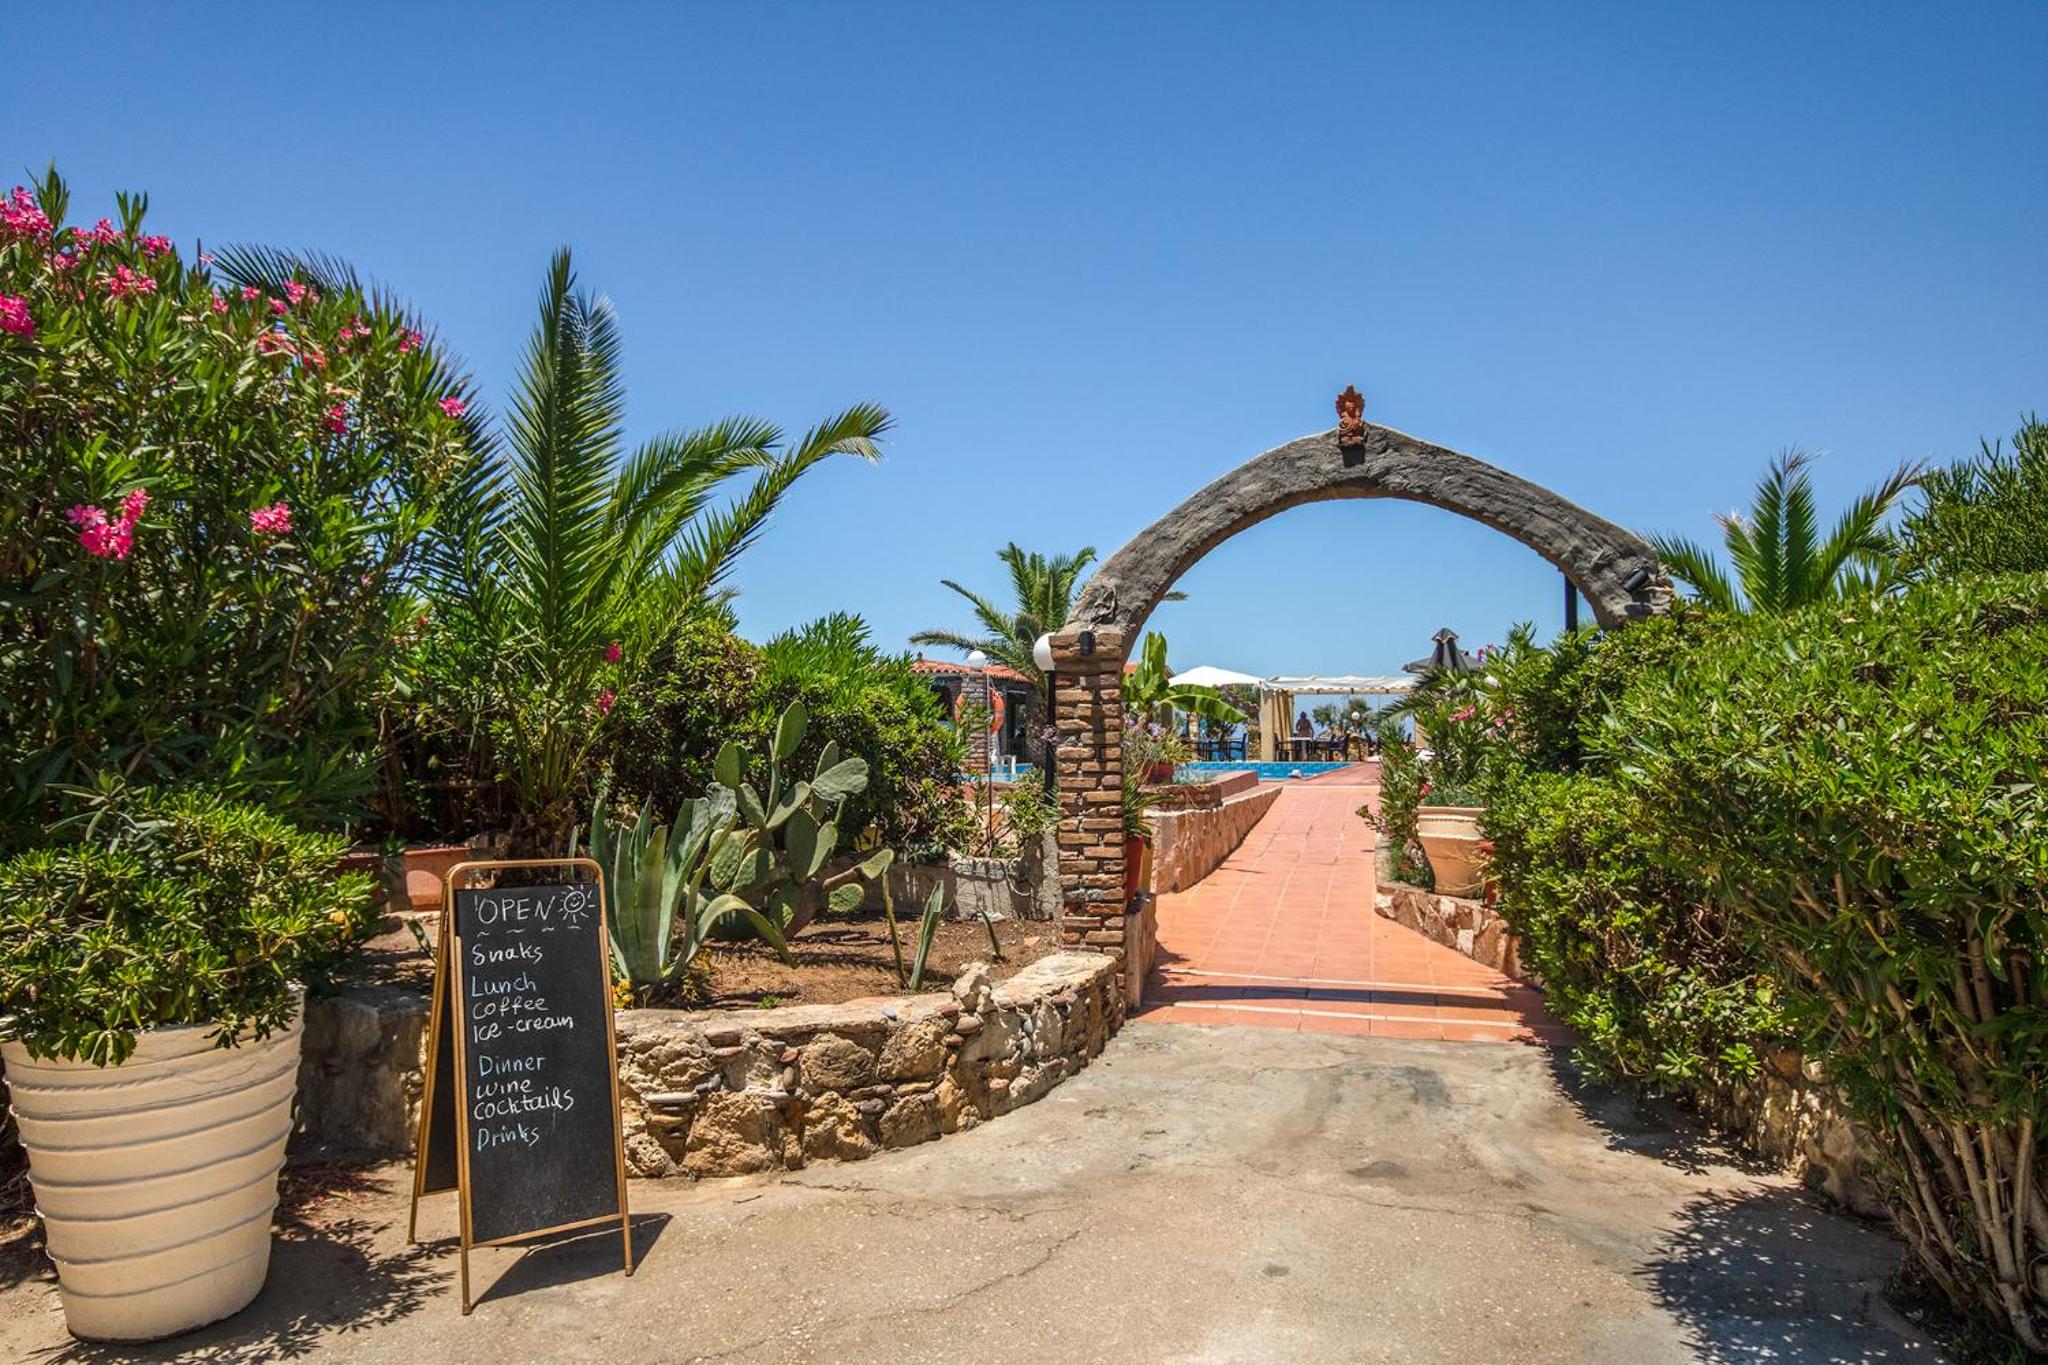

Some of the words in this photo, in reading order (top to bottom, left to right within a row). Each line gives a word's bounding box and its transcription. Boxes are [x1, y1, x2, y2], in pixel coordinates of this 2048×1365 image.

[477, 896, 556, 924] OPEN
[472, 942, 543, 965] Snaks
[471, 972, 536, 997] Lunch
[479, 1055, 547, 1076] Dinner
[477, 1123, 540, 1152] Drinks
